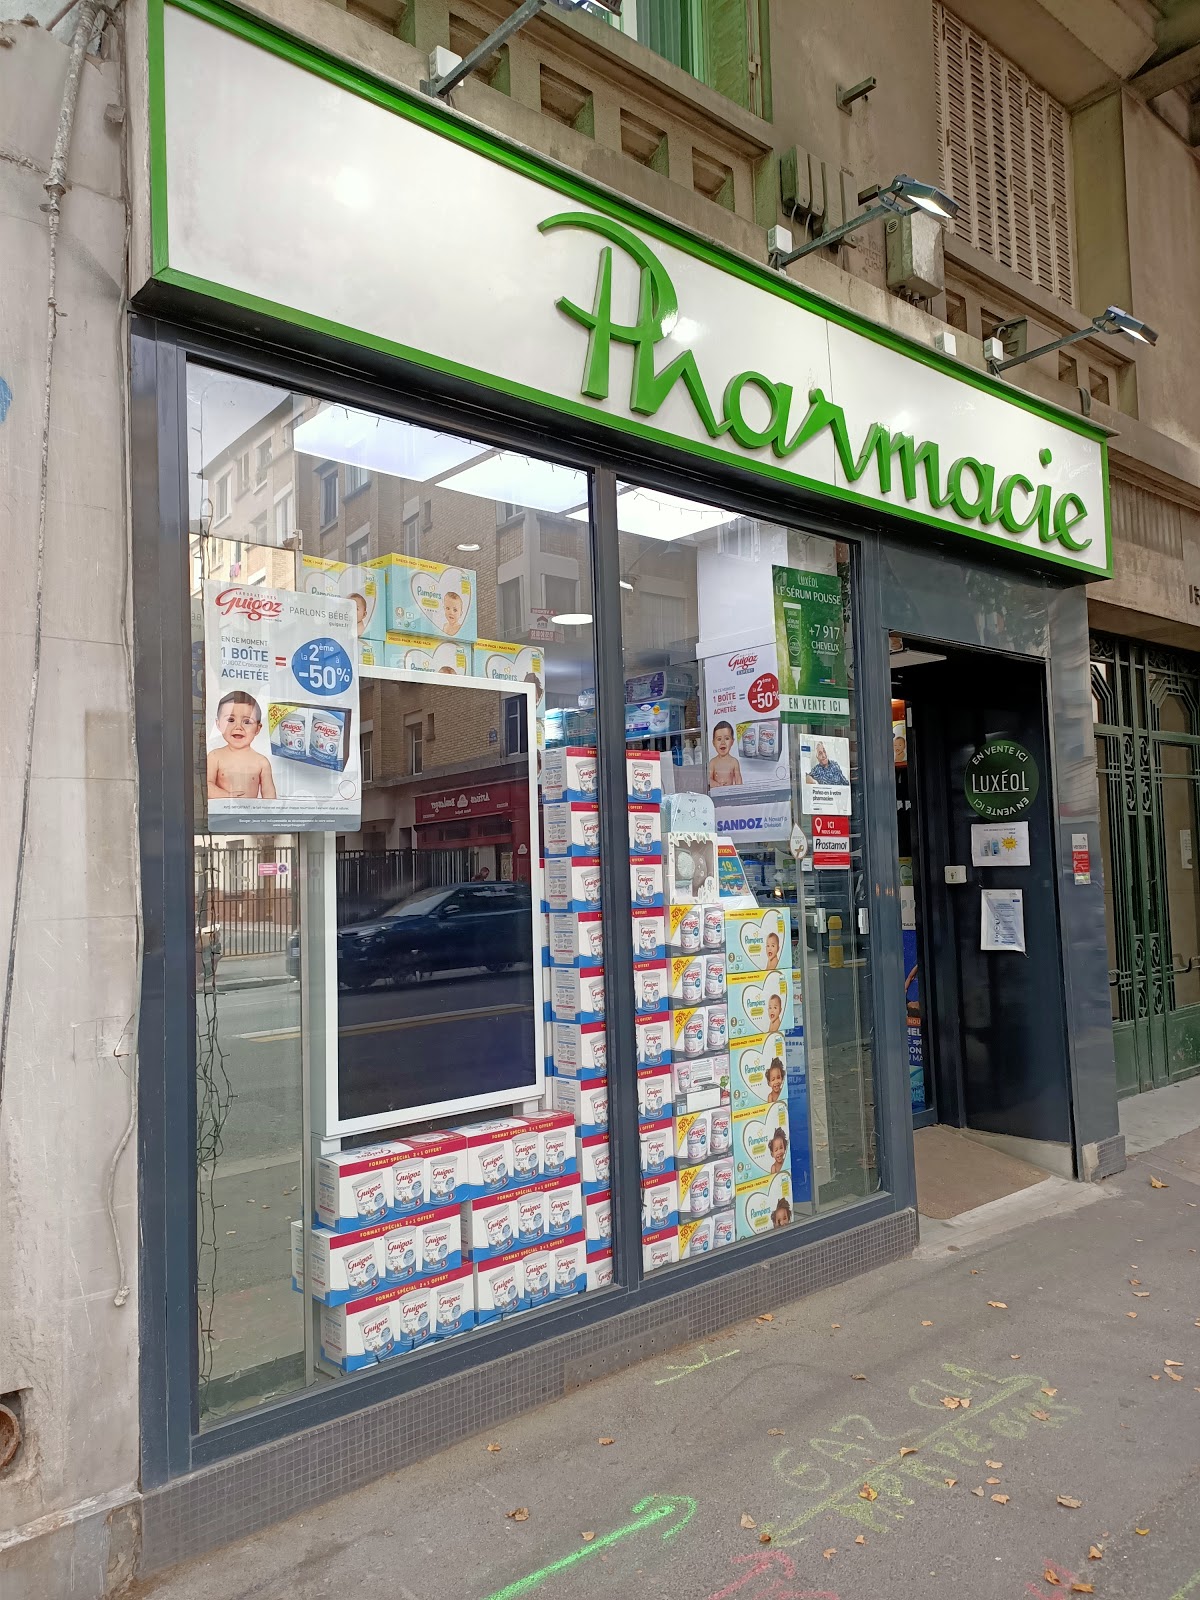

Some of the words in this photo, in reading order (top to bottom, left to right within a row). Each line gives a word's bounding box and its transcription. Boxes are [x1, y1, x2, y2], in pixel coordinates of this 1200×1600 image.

[537, 211, 1092, 552] Pharmacie
[797, 574, 818, 589] LUXÉOL
[416, 586, 442, 601] Pampers
[775, 585, 785, 596] LE
[786, 585, 812, 600] SÉRUM
[813, 591, 841, 606] POUSSE
[214, 588, 284, 622] Guigoz
[289, 606, 326, 620] PARLONS
[221, 635, 228, 643] EN
[240, 637, 268, 646] MOMENT
[811, 640, 840, 653] CHEVEUX
[220, 647, 226, 658] 1
[231, 646, 269, 662] BOÎTE
[727, 652, 759, 672] Guigoz
[221, 668, 269, 683] ACHETÉE
[717, 692, 737, 703] BOÎTE
[713, 704, 737, 715] ACHETÉE
[789, 698, 799, 710] EN
[802, 698, 826, 711] VENTE
[830, 700, 841, 712] ICI
[313, 721, 338, 737] Guigoz
[972, 752, 985, 765] EN
[984, 745, 1015, 757] VENTE
[1015, 748, 1029, 763] ICI
[633, 769, 651, 780] Guigoz
[971, 769, 1030, 794] LUXÉOL
[973, 797, 986, 811] ICI
[1015, 796, 1030, 810] EN
[985, 805, 1016, 817] VENTE
[636, 822, 652, 832] Guigoz
[716, 817, 763, 832] SANDOZ
[827, 821, 835, 829] ICI
[637, 874, 654, 885] Guigoz
[640, 927, 656, 938] Guigoz
[744, 935, 764, 945] Pampers
[643, 980, 659, 991] Guigoz
[746, 998, 766, 1008] Pampers
[646, 1034, 662, 1044] Guigoz
[744, 1064, 766, 1075] Pampers
[646, 1087, 662, 1098] Guigoz
[491, 1132, 509, 1140] FORMAT
[509, 1128, 527, 1137] SPÉCIAL
[538, 1122, 554, 1130] OFFERT
[545, 1142, 564, 1153] Guigoz
[648, 1142, 665, 1152] Guigoz
[748, 1135, 769, 1147] Pampers
[368, 1158, 389, 1168] FORMAT
[390, 1153, 411, 1164] SPÉCIAL
[424, 1146, 442, 1156] OFFERT
[515, 1143, 536, 1157] Guigoz
[482, 1154, 504, 1170] Guigoz
[396, 1170, 422, 1186] Guigoz
[432, 1167, 454, 1179] Guigoz
[357, 1183, 381, 1200] Guigoz
[497, 1193, 514, 1202] FORMAT
[515, 1188, 533, 1197] SPÉCIAL
[544, 1180, 560, 1189] OFFERT
[550, 1200, 570, 1212] Guigoz
[652, 1196, 668, 1207] Guigoz
[519, 1203, 541, 1216] Guigoz
[750, 1207, 771, 1219] Pampers
[359, 1229, 381, 1238] FORMAT
[382, 1223, 403, 1233] SPÉCIAL
[417, 1213, 435, 1223] OFFERT
[487, 1216, 509, 1232] Guigoz
[387, 1238, 414, 1255] Guigoz
[425, 1233, 448, 1248] Guigoz
[502, 1253, 520, 1262] FORMAT
[520, 1248, 538, 1258] SPÉCIAL
[549, 1238, 565, 1248] OFFERT
[652, 1252, 669, 1262] Guigoz
[347, 1253, 373, 1273] Guigoz
[526, 1262, 547, 1276] Guigoz
[557, 1258, 576, 1270] Guigoz
[375, 1291, 396, 1303] FORMAT
[396, 1284, 417, 1295] SPÉCIAL
[430, 1274, 449, 1284] OFFERT
[493, 1276, 514, 1293] Guigoz
[438, 1295, 461, 1307] Guigoz
[402, 1301, 428, 1318] Guigoz
[363, 1318, 388, 1337] Guigoz
